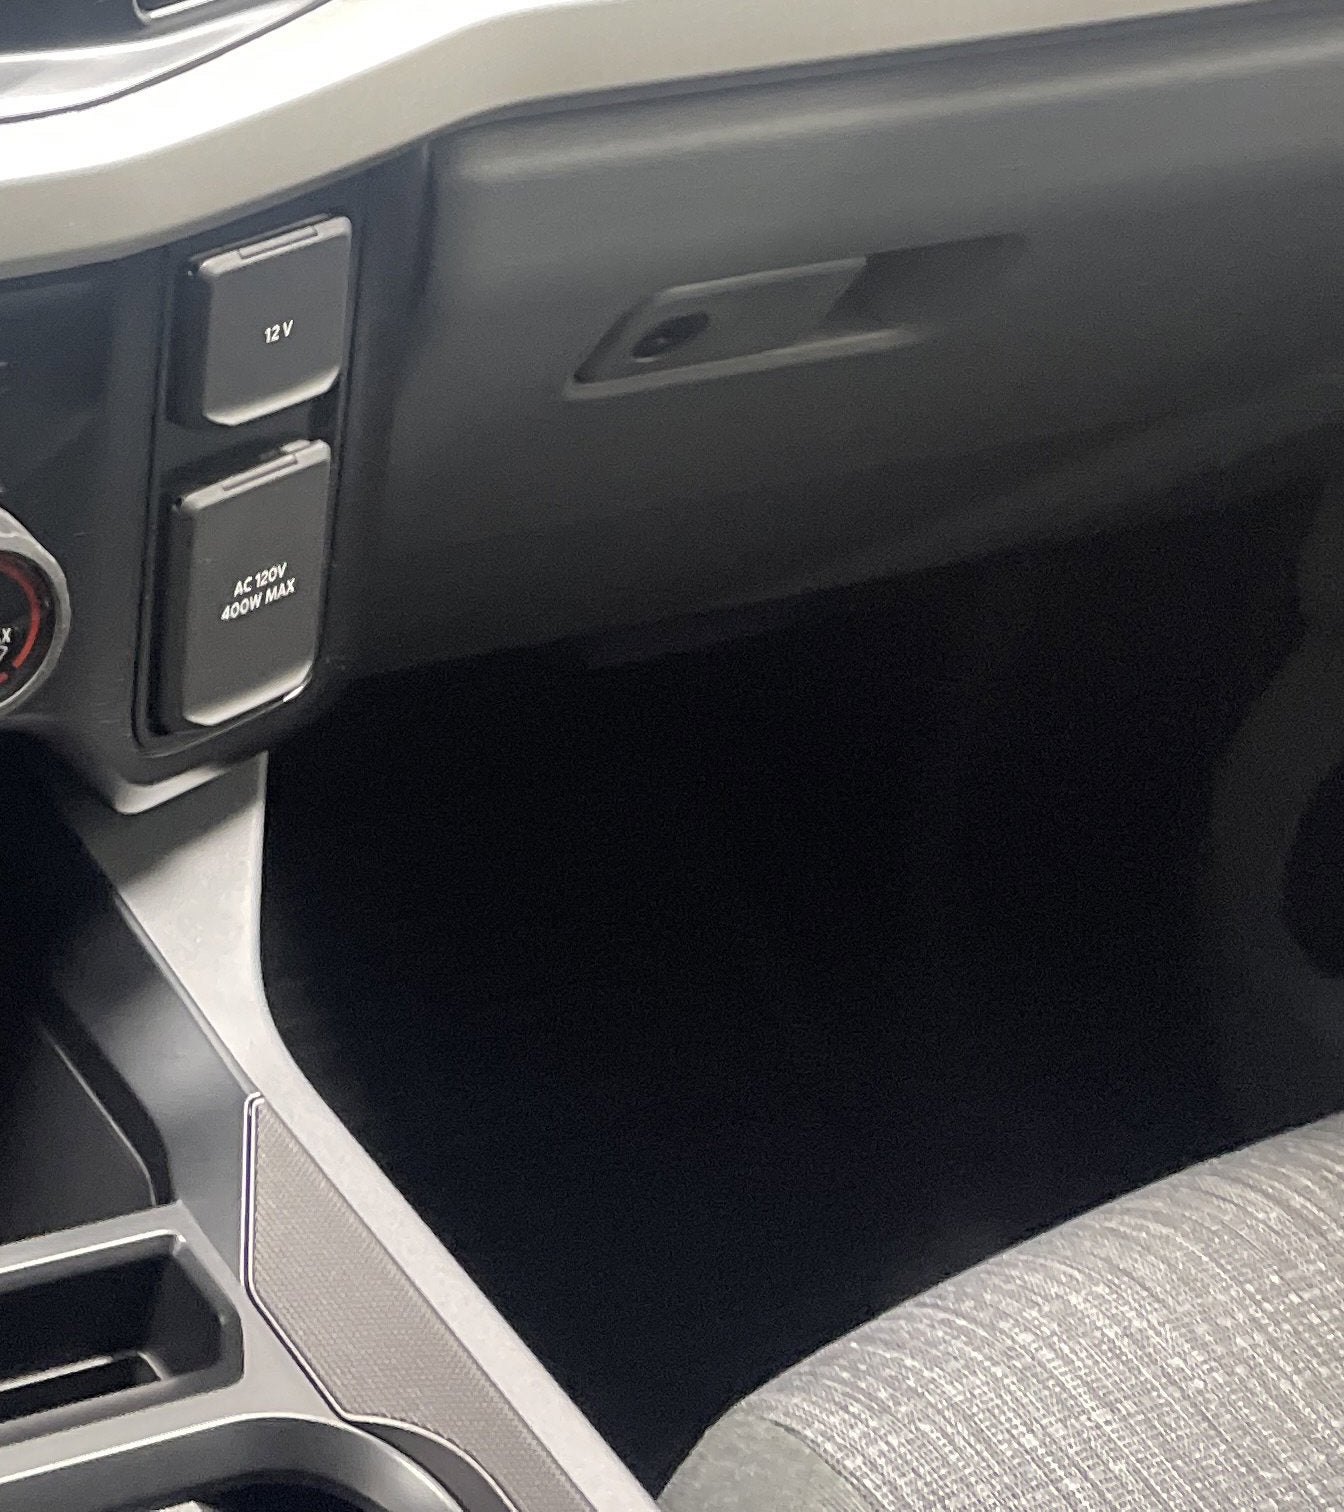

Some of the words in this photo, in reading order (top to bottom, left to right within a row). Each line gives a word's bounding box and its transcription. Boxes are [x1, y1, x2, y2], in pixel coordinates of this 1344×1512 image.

[264, 324, 281, 344] 12
[233, 575, 253, 598] AC
[254, 561, 288, 588] 120V
[220, 591, 263, 621] 400W
[264, 577, 296, 605] MAX
